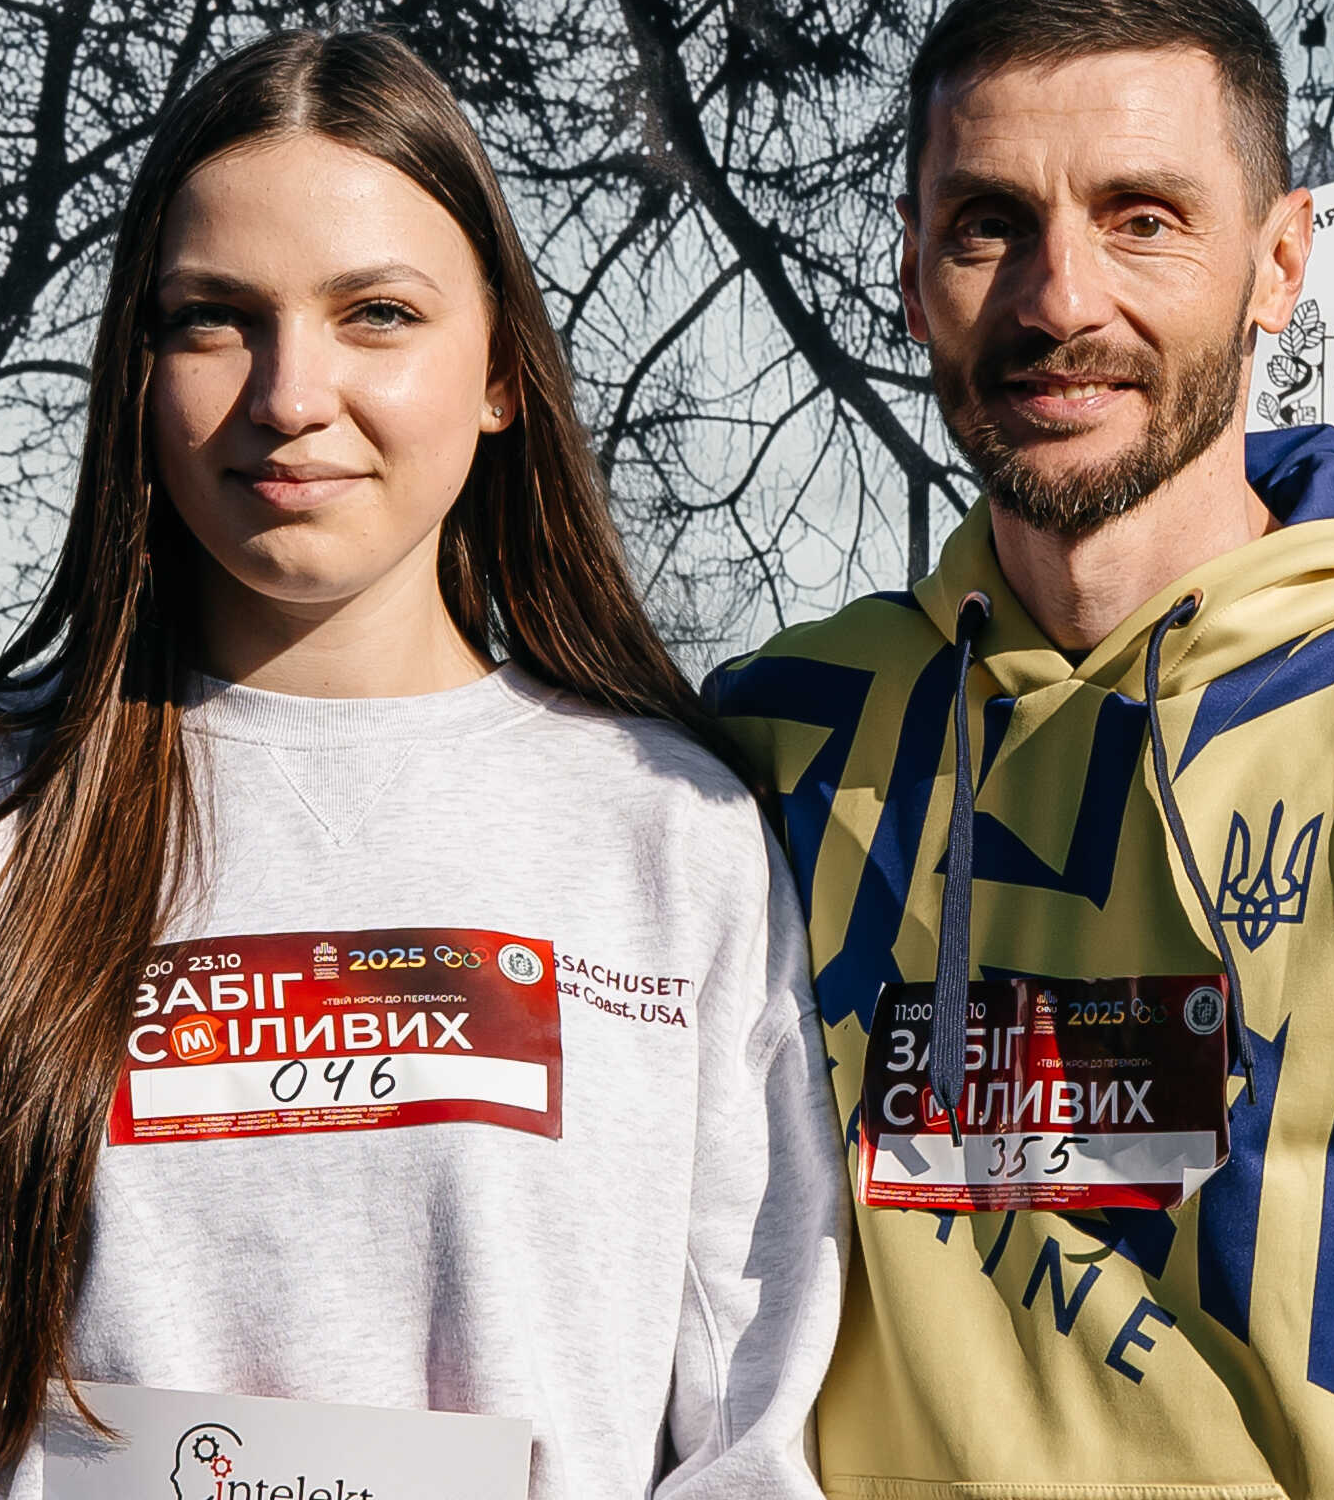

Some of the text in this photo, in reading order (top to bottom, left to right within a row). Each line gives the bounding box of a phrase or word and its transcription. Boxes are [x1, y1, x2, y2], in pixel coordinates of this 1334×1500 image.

[187, 953, 242, 972] 23.10
[348, 947, 427, 971] 2025
[132, 972, 303, 1018] ЗАБІГ
[354, 996, 384, 1004] КРОК
[384, 995, 401, 1004] ДО
[583, 987, 636, 1021] Coast,
[640, 1003, 689, 1028] USA
[894, 1003, 933, 1021] 11:00
[1068, 1001, 1125, 1026] 2025
[127, 1011, 474, 1064] СМІЛИВИХ
[269, 1056, 397, 1103] 046
